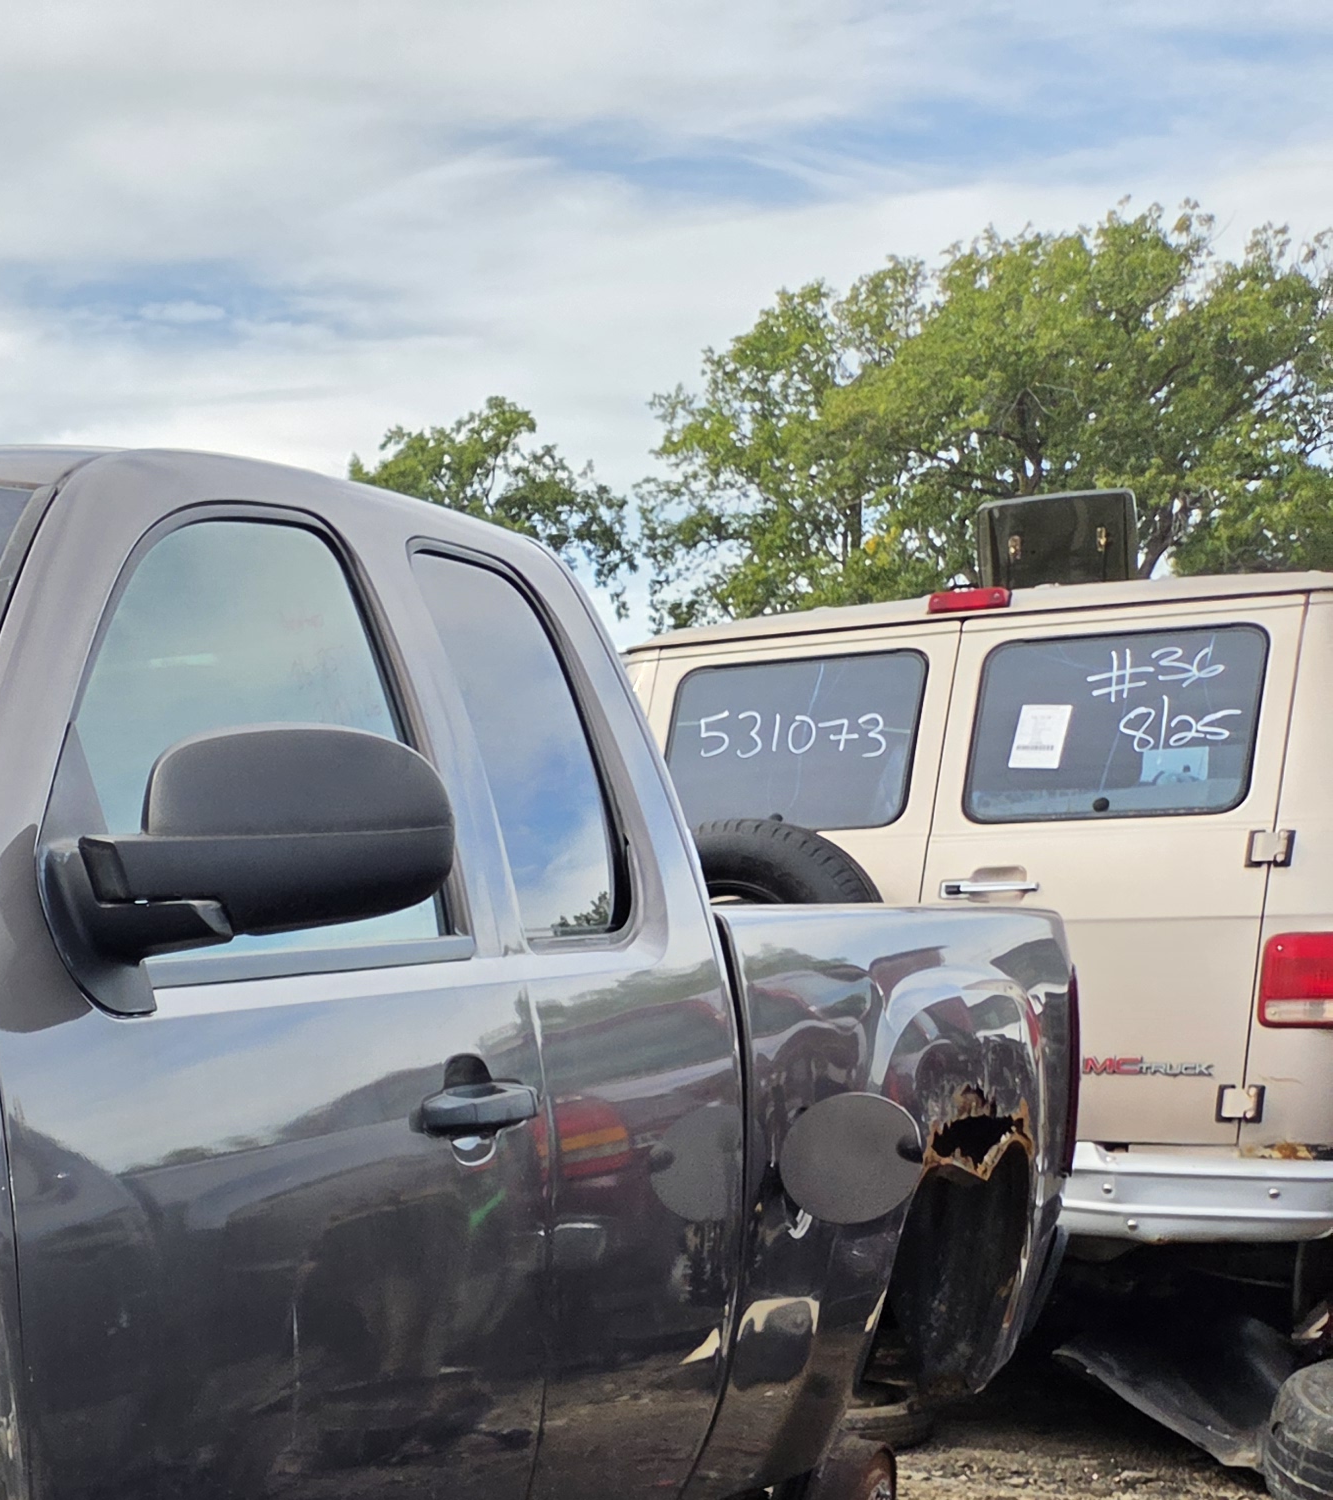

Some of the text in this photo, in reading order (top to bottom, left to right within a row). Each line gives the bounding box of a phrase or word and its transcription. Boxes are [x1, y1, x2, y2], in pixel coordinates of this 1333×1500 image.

[1086, 648, 1225, 702] #36
[700, 710, 886, 758] 531073
[1119, 695, 1241, 753] 8/25
[1083, 1056, 1142, 1076] MC
